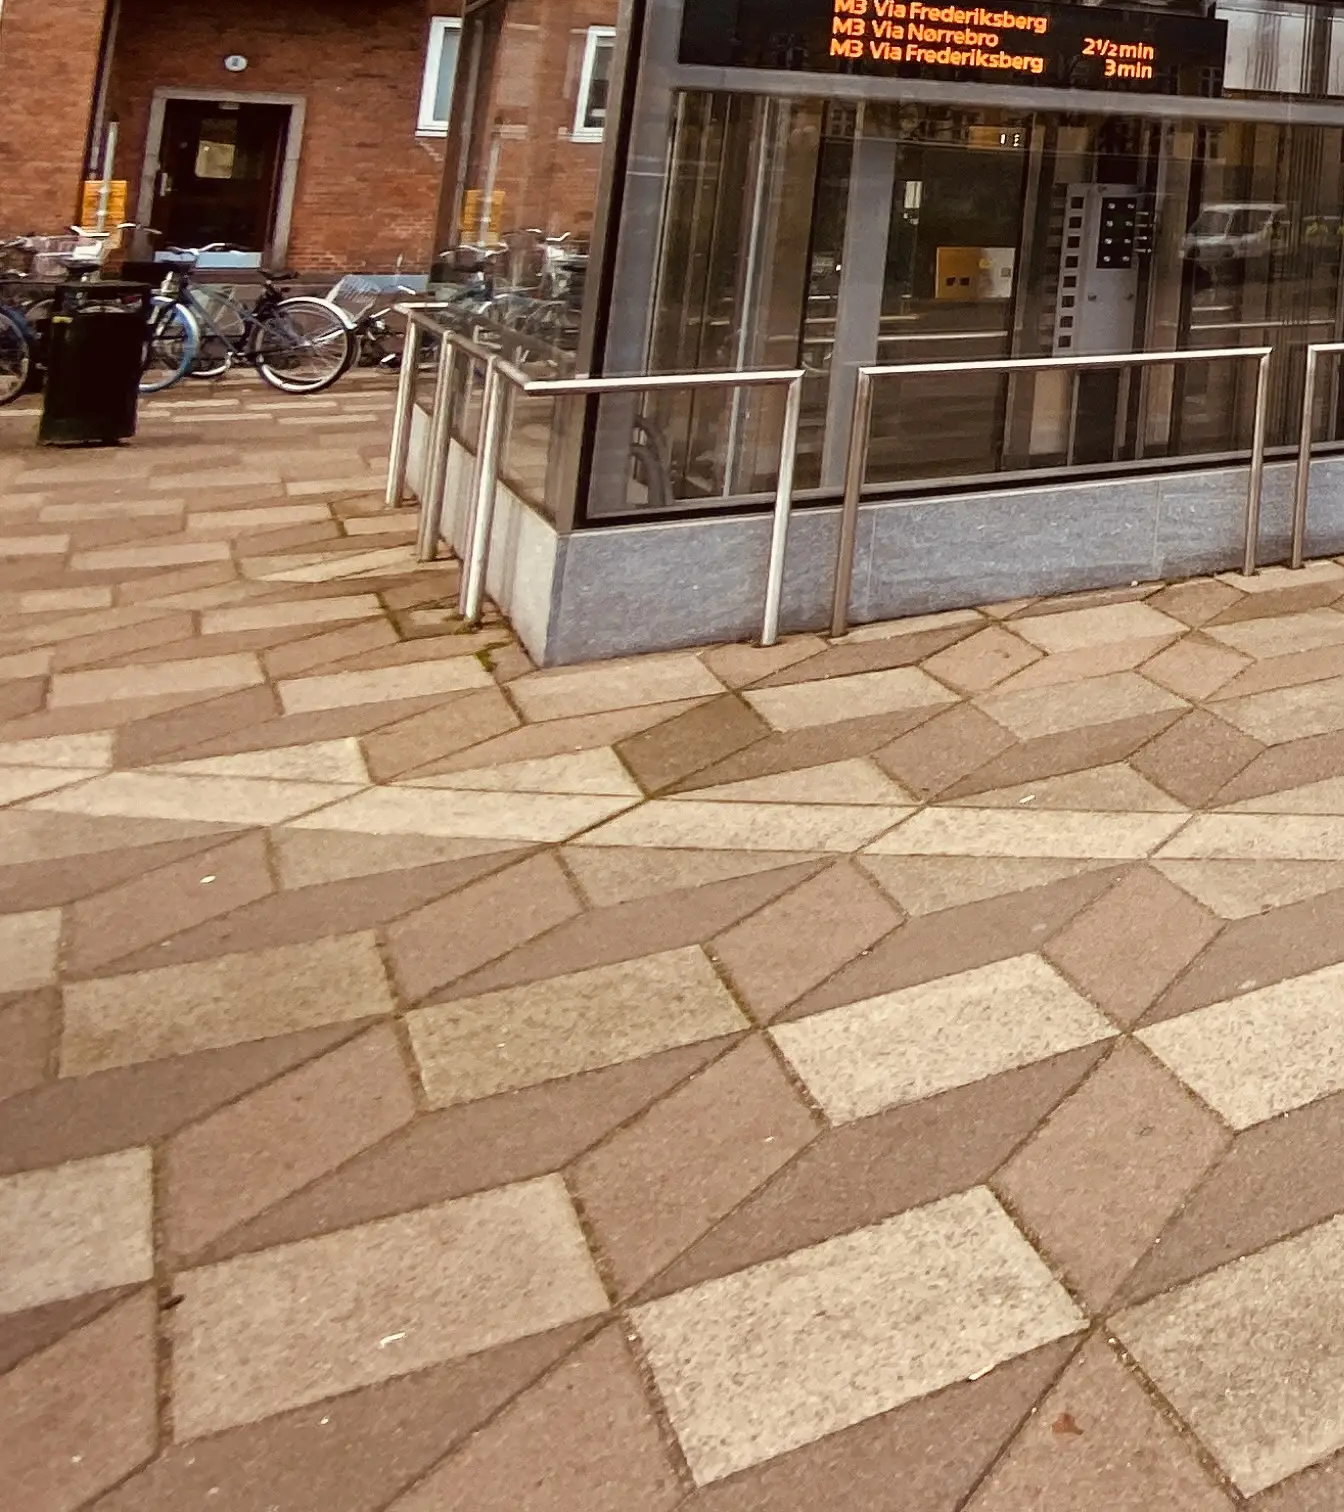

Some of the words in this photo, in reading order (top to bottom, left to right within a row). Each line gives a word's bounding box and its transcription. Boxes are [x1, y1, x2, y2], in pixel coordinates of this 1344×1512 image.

[832, 16, 866, 36] M3
[871, 19, 904, 40] Via
[907, 23, 999, 48] Nørrebro
[909, 1, 1048, 34] Frederiksberg
[829, 38, 863, 58] M3
[869, 40, 902, 61] Via
[905, 44, 1045, 74] Frederiksberg
